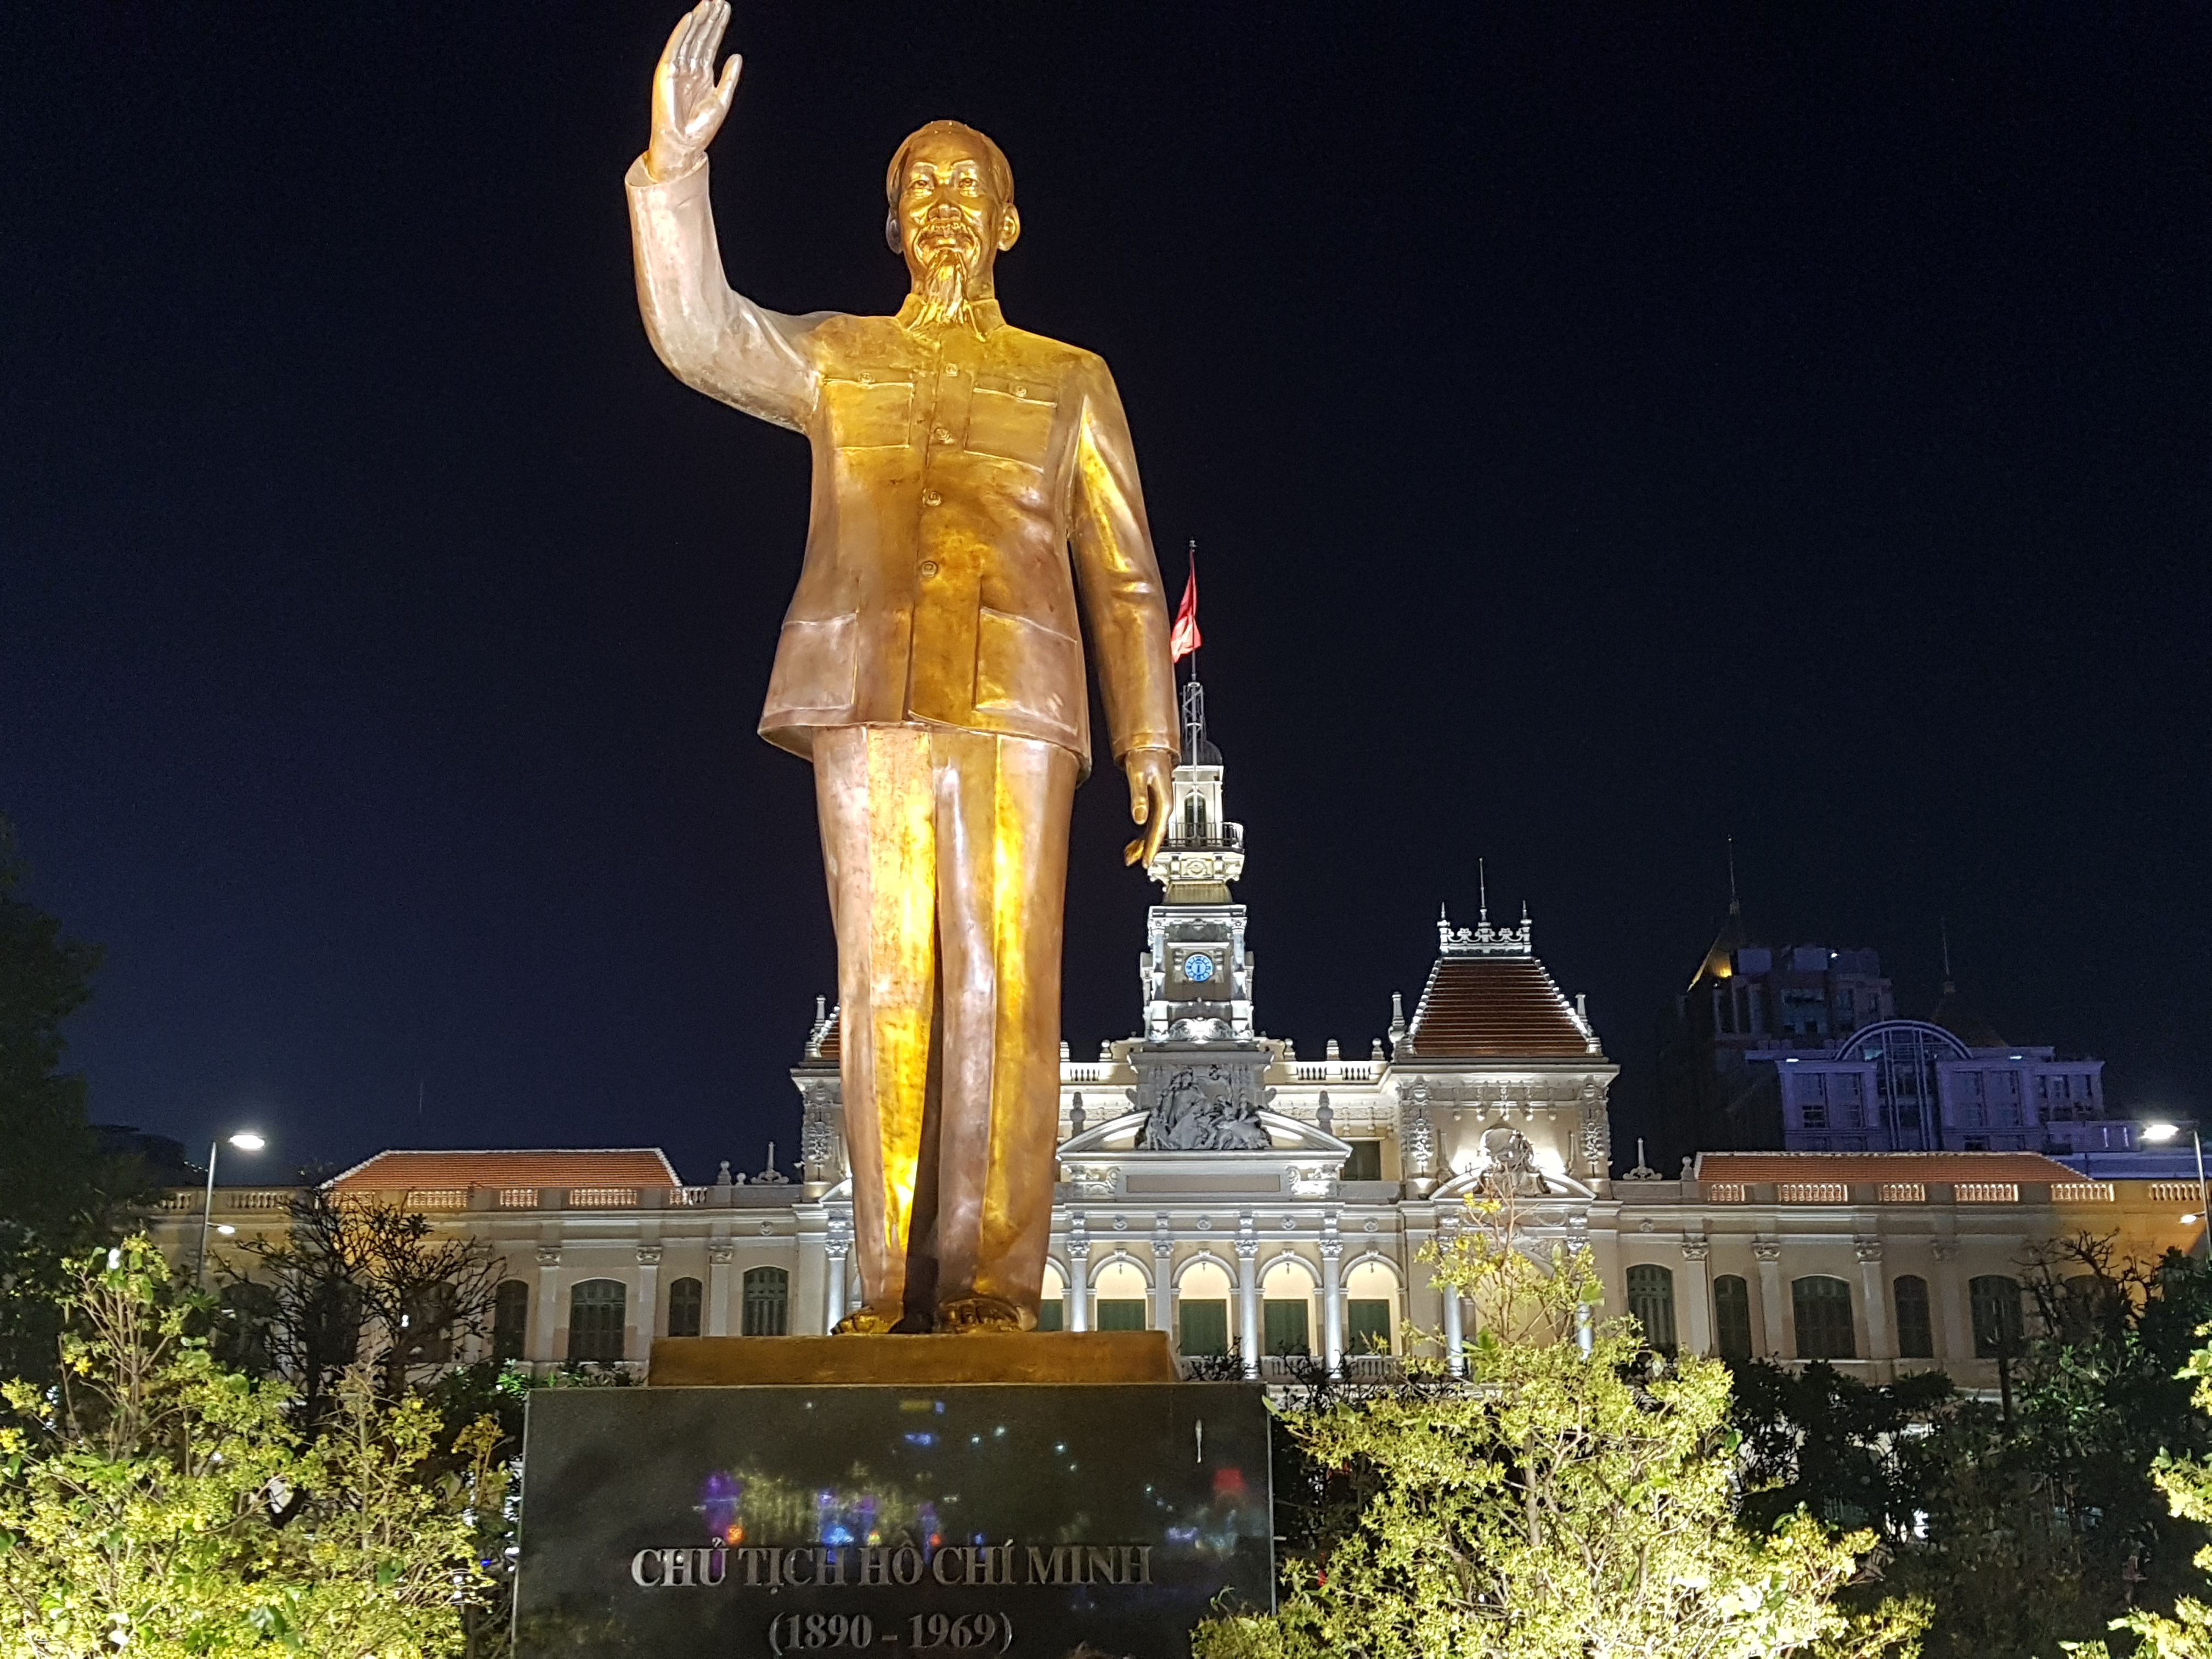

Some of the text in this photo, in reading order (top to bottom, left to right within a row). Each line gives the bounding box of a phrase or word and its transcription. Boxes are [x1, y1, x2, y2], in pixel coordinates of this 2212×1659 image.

[631, 1530, 1153, 1595] CHỦ TỊCH HỒ CHÍ MINH
[769, 1612, 872, 1656] (1890
[908, 1611, 1012, 1655] 1969)
